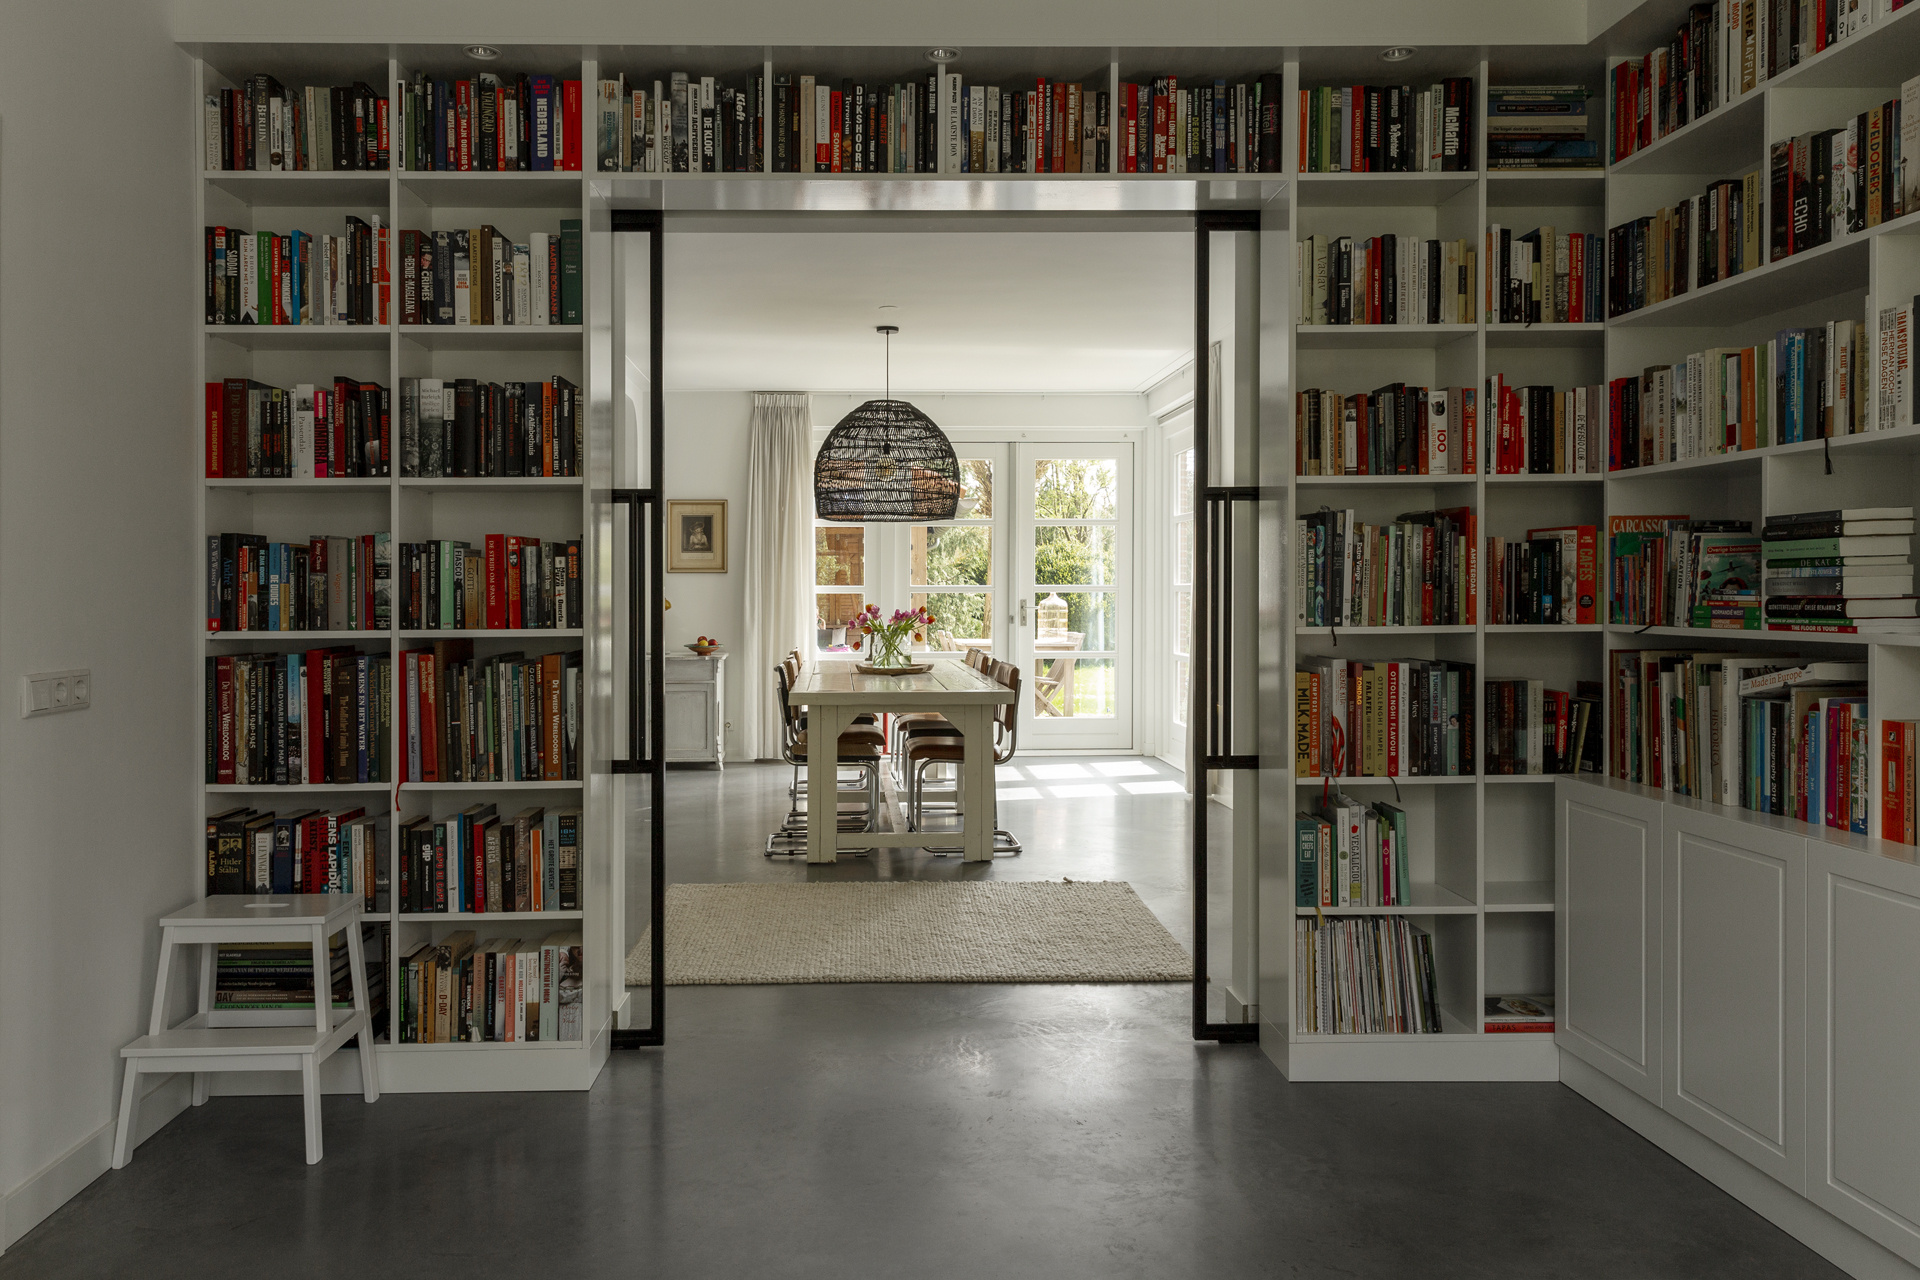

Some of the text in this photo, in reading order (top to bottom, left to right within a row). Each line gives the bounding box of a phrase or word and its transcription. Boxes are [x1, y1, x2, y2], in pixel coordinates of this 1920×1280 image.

[482, 91, 494, 133] STALINGRAD
[634, 93, 642, 118] LIBERATION
[736, 93, 745, 121] Kieft
[950, 106, 957, 114] DE
[536, 98, 548, 158] NEDERLAND
[1192, 117, 1199, 126] DE
[1445, 107, 1460, 155] McMaffia
[704, 117, 713, 157] DE KLOOF
[1794, 197, 1808, 234] ECHO
[227, 250, 237, 276] SADDAM
[421, 271, 431, 301] CRIMES
[550, 275, 558, 314] BORMANN
[1897, 310, 1908, 370] TRAINSPOTTING
[1437, 430, 1446, 452] 100
[489, 540, 494, 548] DE
[489, 573, 494, 583] OM
[1580, 548, 1594, 581] CAFÉS
[334, 573, 342, 604] Vogelvrij
[359, 660, 364, 670] DE
[552, 680, 559, 688] DE
[359, 696, 365, 706] EN
[258, 845, 267, 882] LENINGRAD
[328, 817, 337, 894] JENS LAPIDUS
[436, 846, 444, 868] CAPO
[436, 882, 444, 902] CAPI
